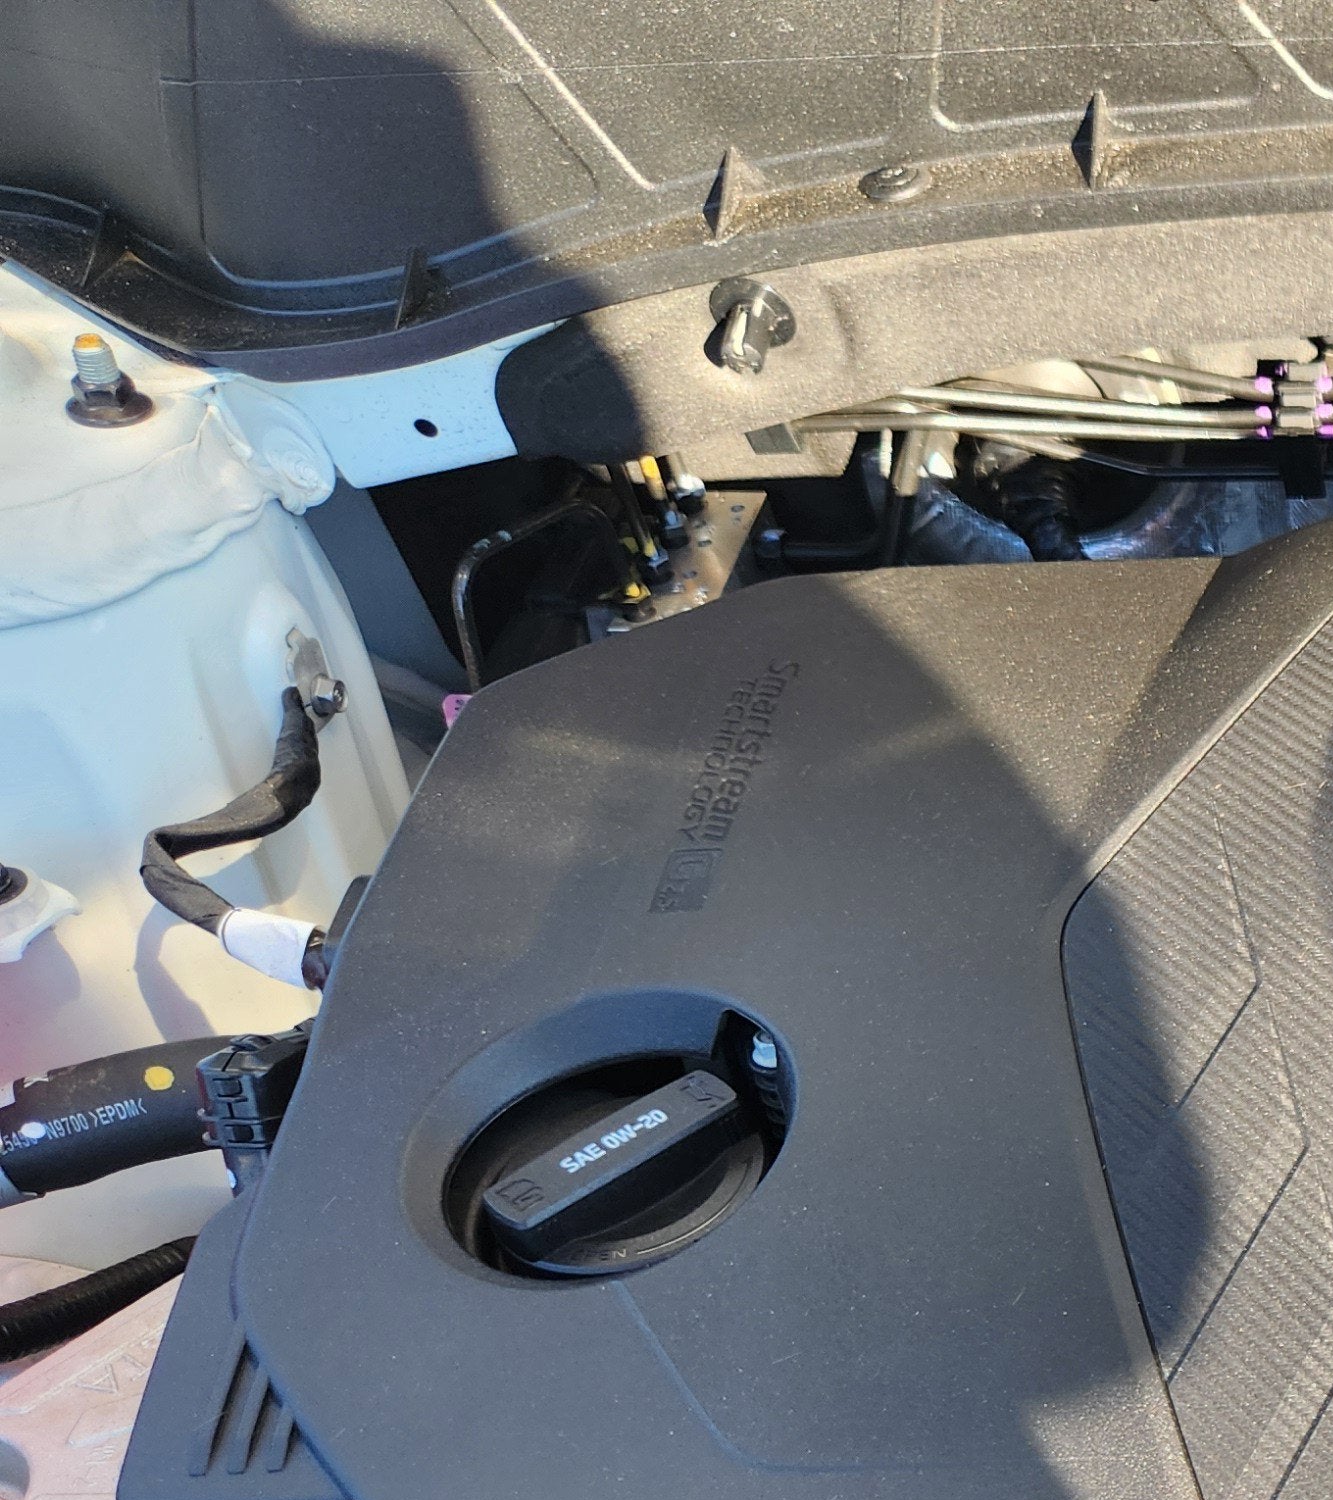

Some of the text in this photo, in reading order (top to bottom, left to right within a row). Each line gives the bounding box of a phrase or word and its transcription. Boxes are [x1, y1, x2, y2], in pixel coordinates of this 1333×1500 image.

[702, 658, 800, 842] Smartstream
[559, 1108, 669, 1174] SAE 0W-20
